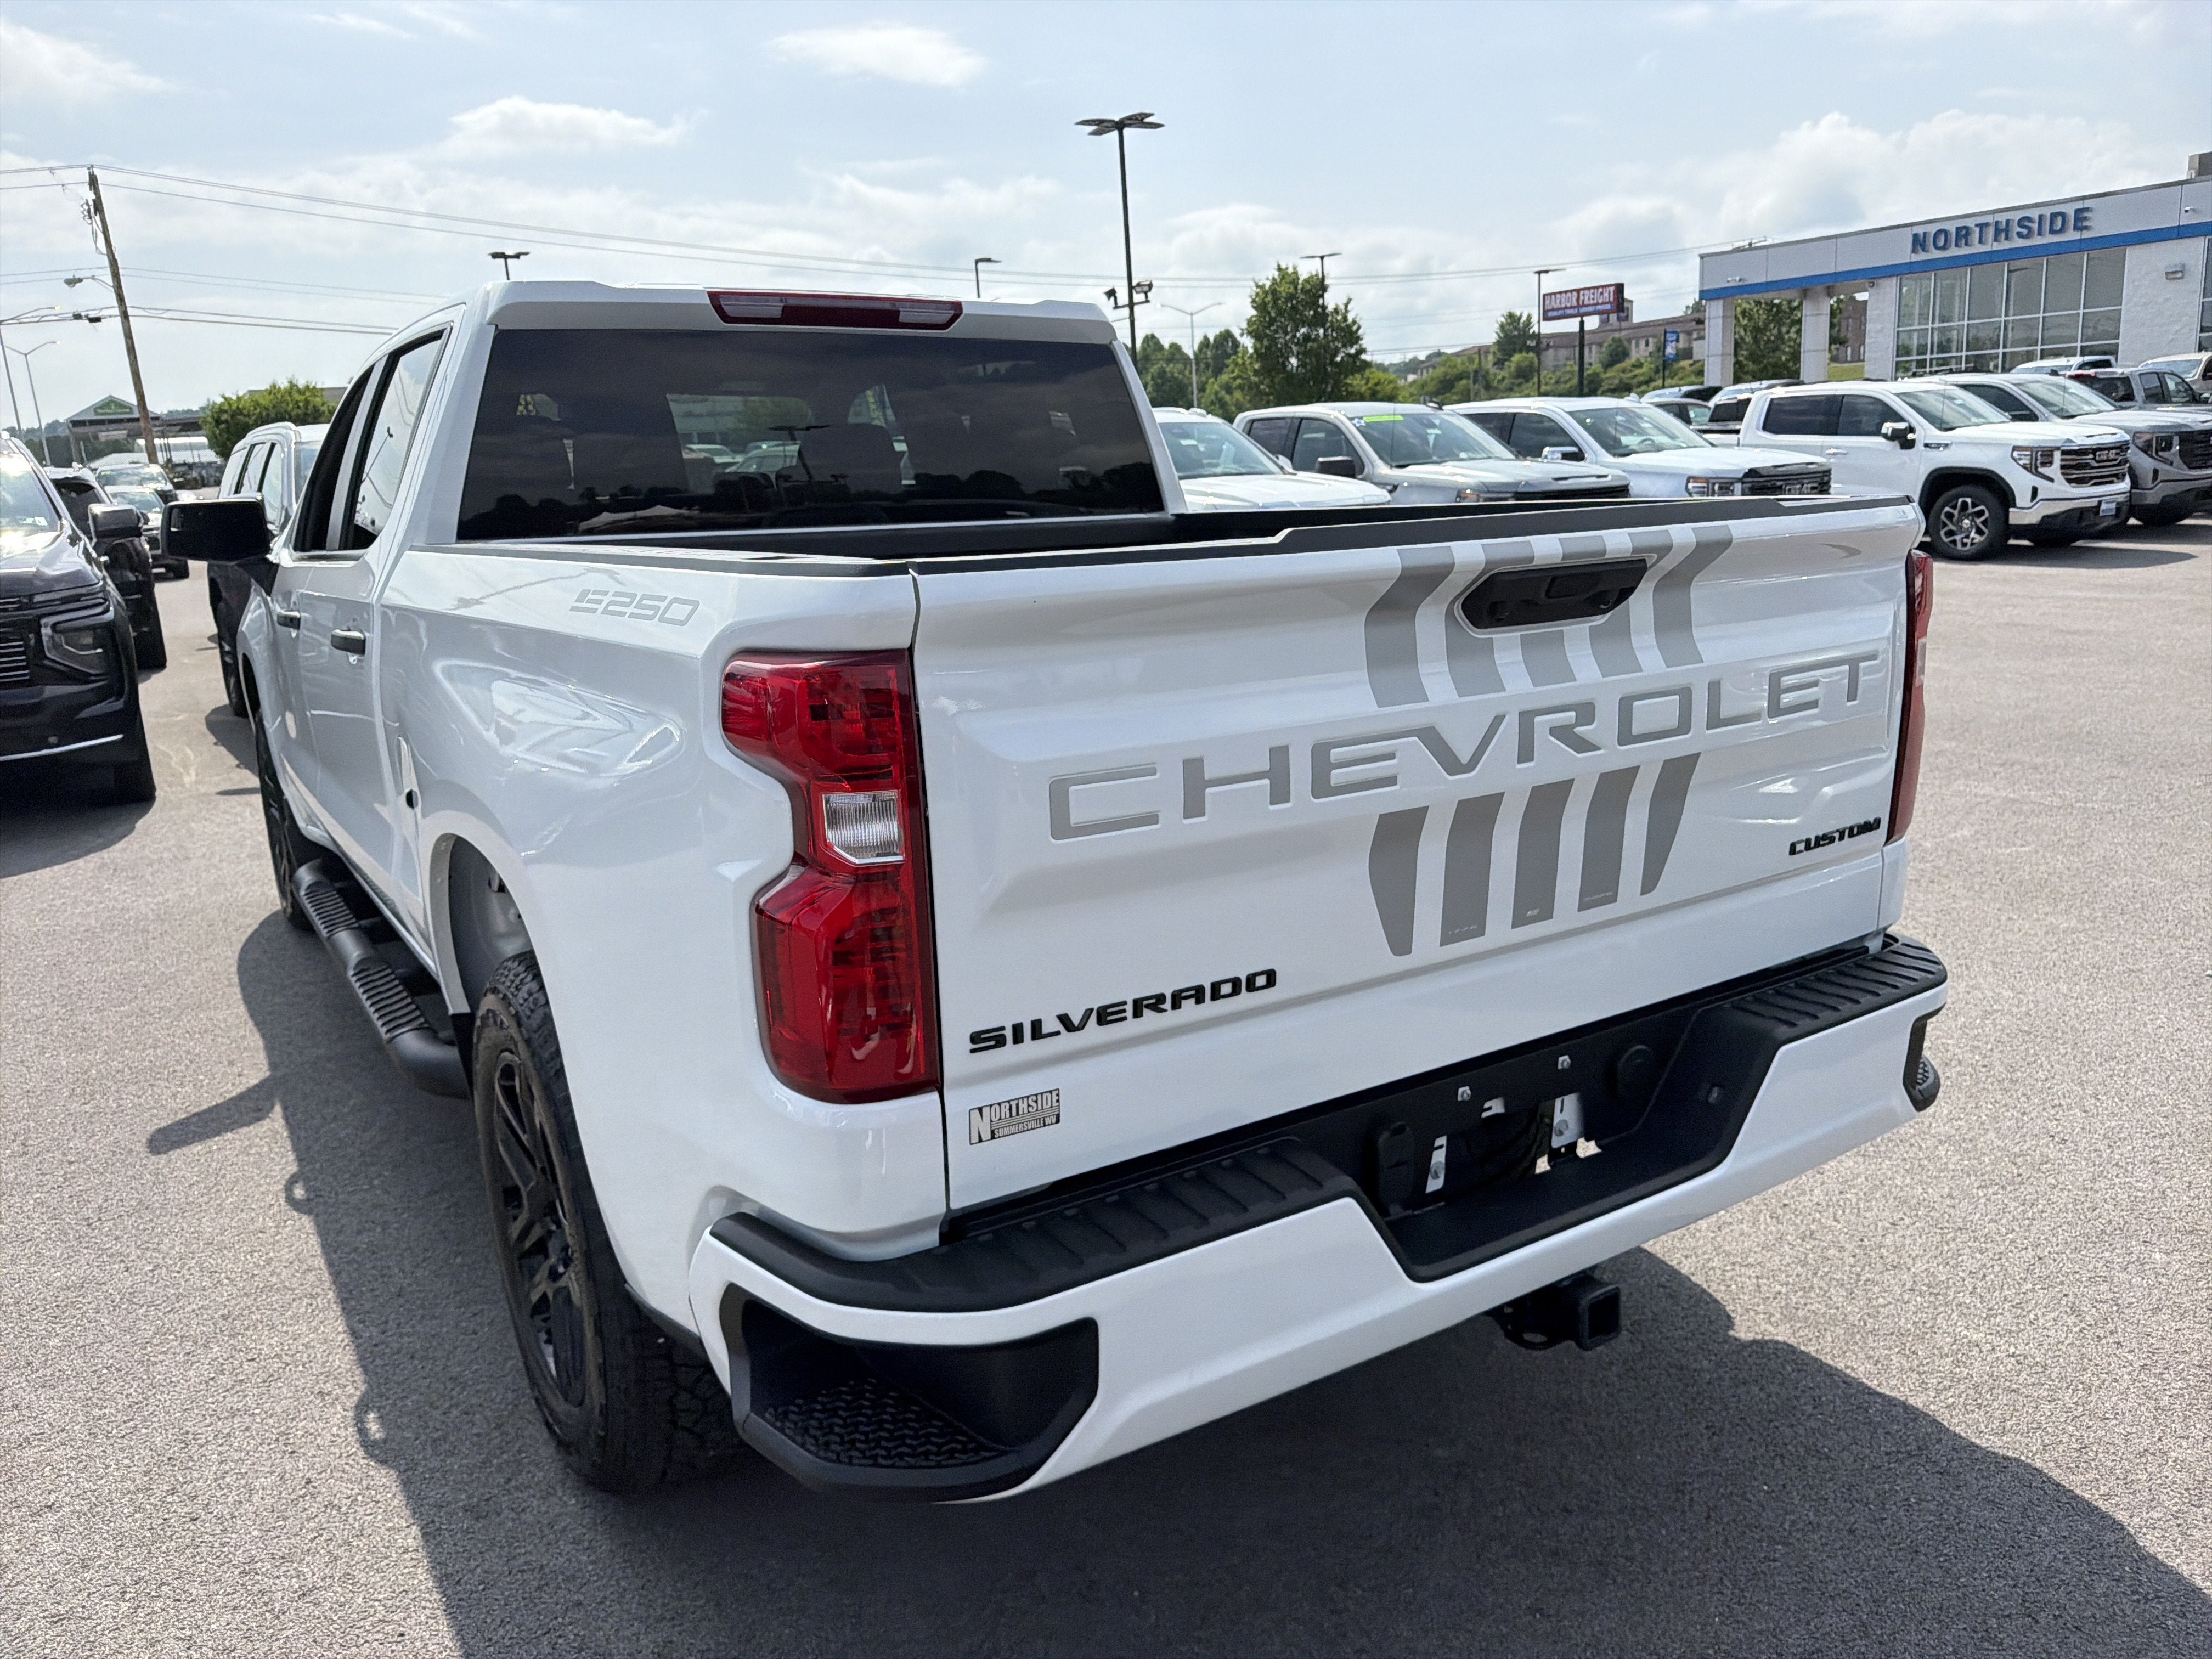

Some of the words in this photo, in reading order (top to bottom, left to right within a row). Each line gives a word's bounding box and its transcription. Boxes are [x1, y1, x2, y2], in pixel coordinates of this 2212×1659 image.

[1911, 206, 2093, 254] NORTHSIDE
[1544, 291, 1578, 310] HARBOR
[1579, 286, 1615, 305] FREIGHT
[1049, 650, 1880, 842] CHEVROLET
[1788, 816, 1881, 856] CUSTOM
[969, 968, 1277, 1054] SILVERADO
[970, 1090, 1059, 1143] NORTHSIDE
[994, 1119, 1044, 1138] SUMMERSVILLE
[1045, 1115, 1056, 1124] WV
